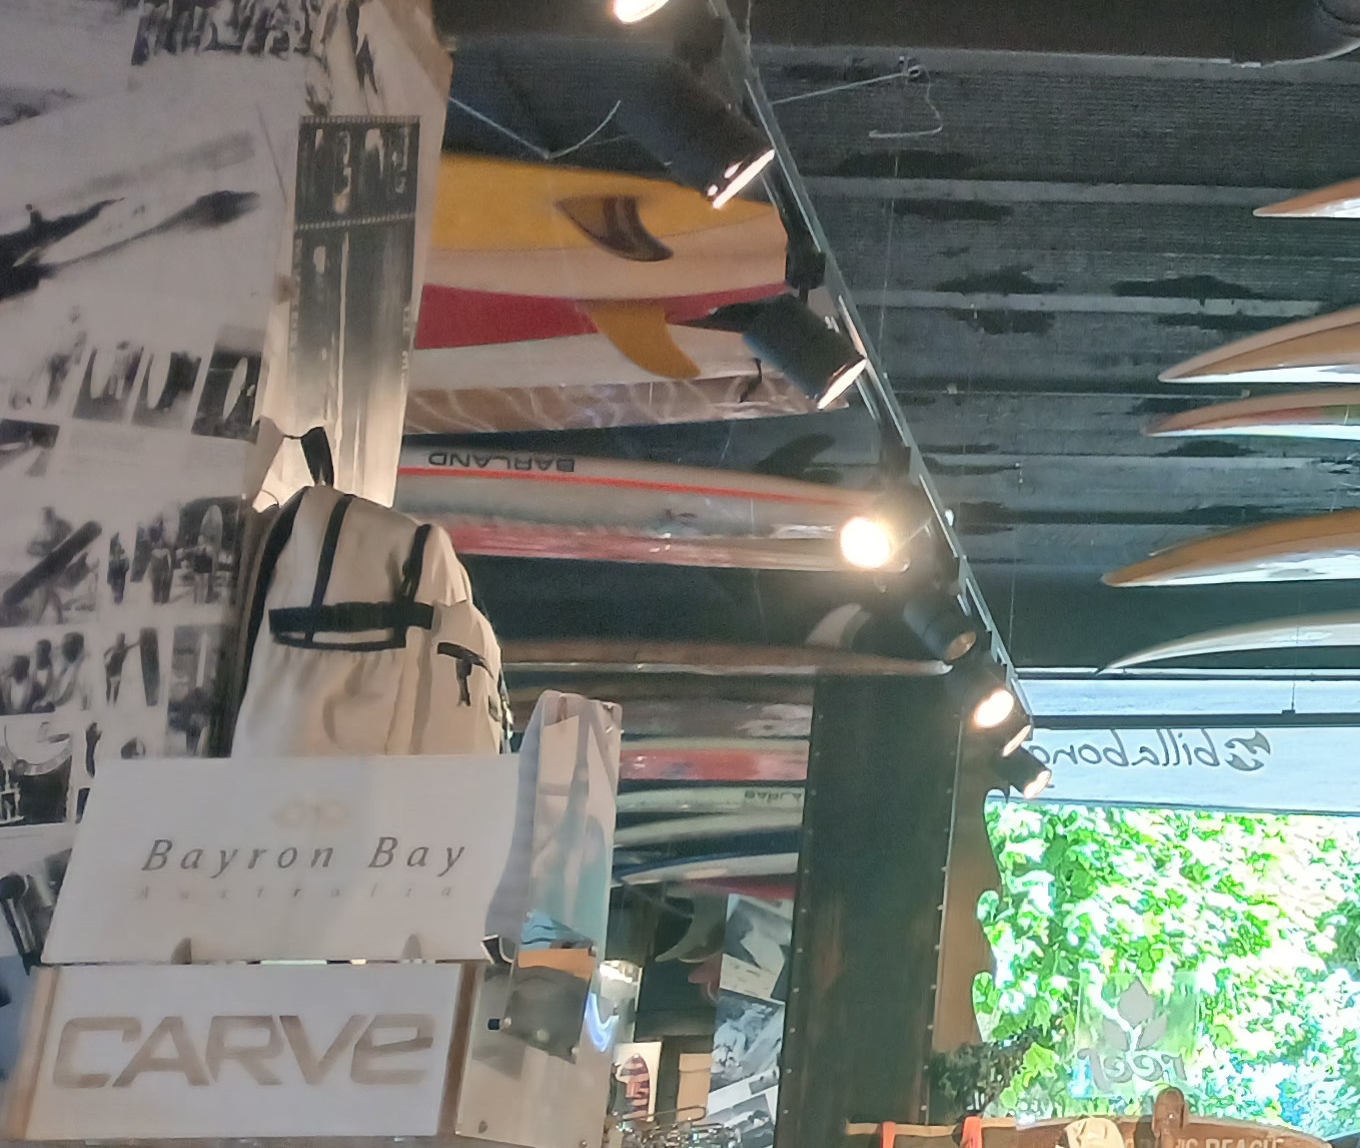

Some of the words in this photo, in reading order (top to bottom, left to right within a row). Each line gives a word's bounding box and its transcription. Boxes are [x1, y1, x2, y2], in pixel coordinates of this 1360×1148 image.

[427, 452, 576, 474] BARLAND
[140, 838, 335, 879] Bayron
[366, 835, 467, 878] Bay
